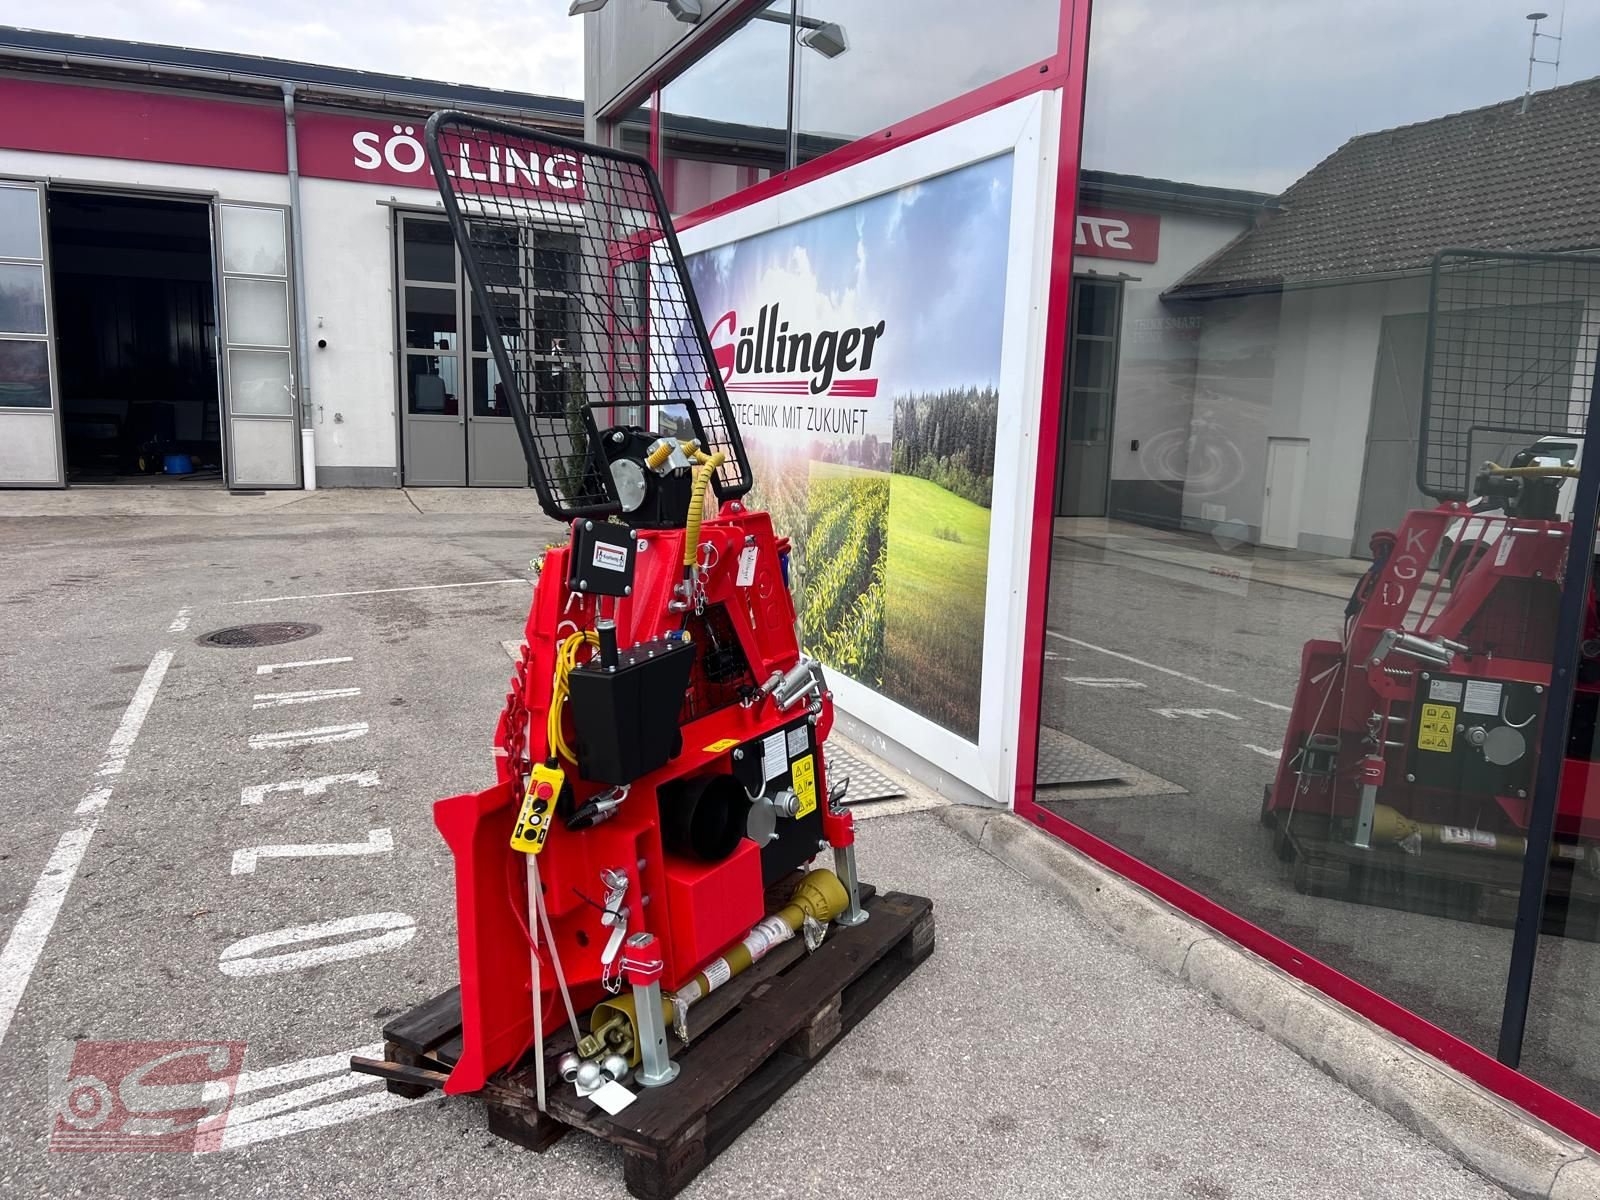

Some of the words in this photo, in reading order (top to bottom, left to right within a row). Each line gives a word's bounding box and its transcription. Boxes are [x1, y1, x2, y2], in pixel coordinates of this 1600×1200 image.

[352, 124, 585, 190] SÖLING
[704, 302, 885, 396] Söllinger
[782, 405, 803, 430] MIT
[807, 406, 868, 435] ZUKUNFT
